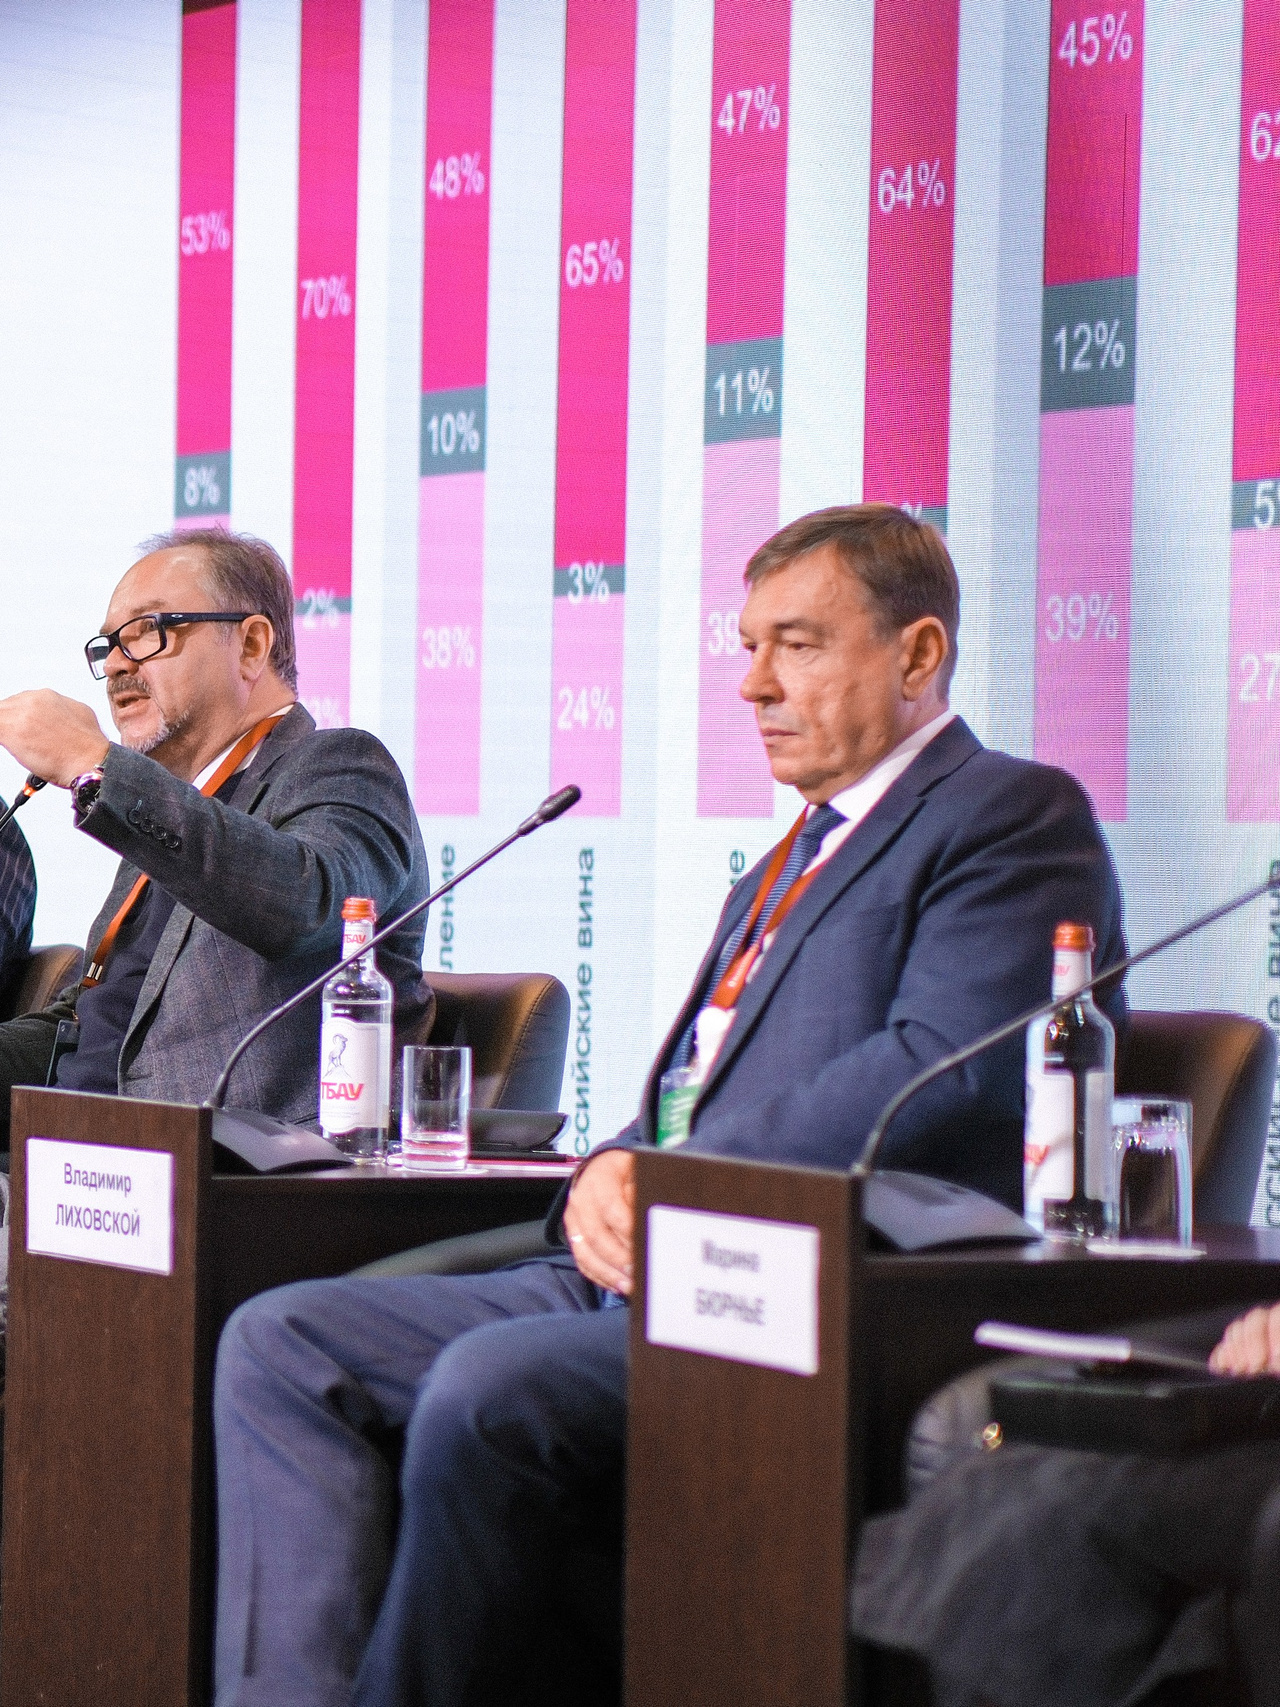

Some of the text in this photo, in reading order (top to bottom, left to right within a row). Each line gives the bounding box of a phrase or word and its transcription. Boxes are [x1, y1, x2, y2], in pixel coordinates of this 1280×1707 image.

[1057, 11, 1134, 68] 45%
[716, 83, 781, 136] 47%
[428, 151, 485, 199] 48%
[876, 159, 946, 213] 64%
[181, 211, 231, 256] 53%
[564, 237, 624, 288] 65%
[301, 275, 352, 319] 70%
[1053, 320, 1125, 373] 12%
[713, 367, 775, 416] 11%
[427, 411, 480, 456] 10%
[184, 467, 219, 507] 8%
[567, 560, 610, 604] 3%
[302, 587, 340, 629] 2%
[1044, 592, 1119, 644] 39%
[422, 625, 475, 670] 38%
[556, 685, 616, 732] 24%
[578, 847, 594, 949] вина
[63, 1162, 132, 1198] Владимир
[55, 1203, 141, 1237] ЛИХОВСКОЙ
